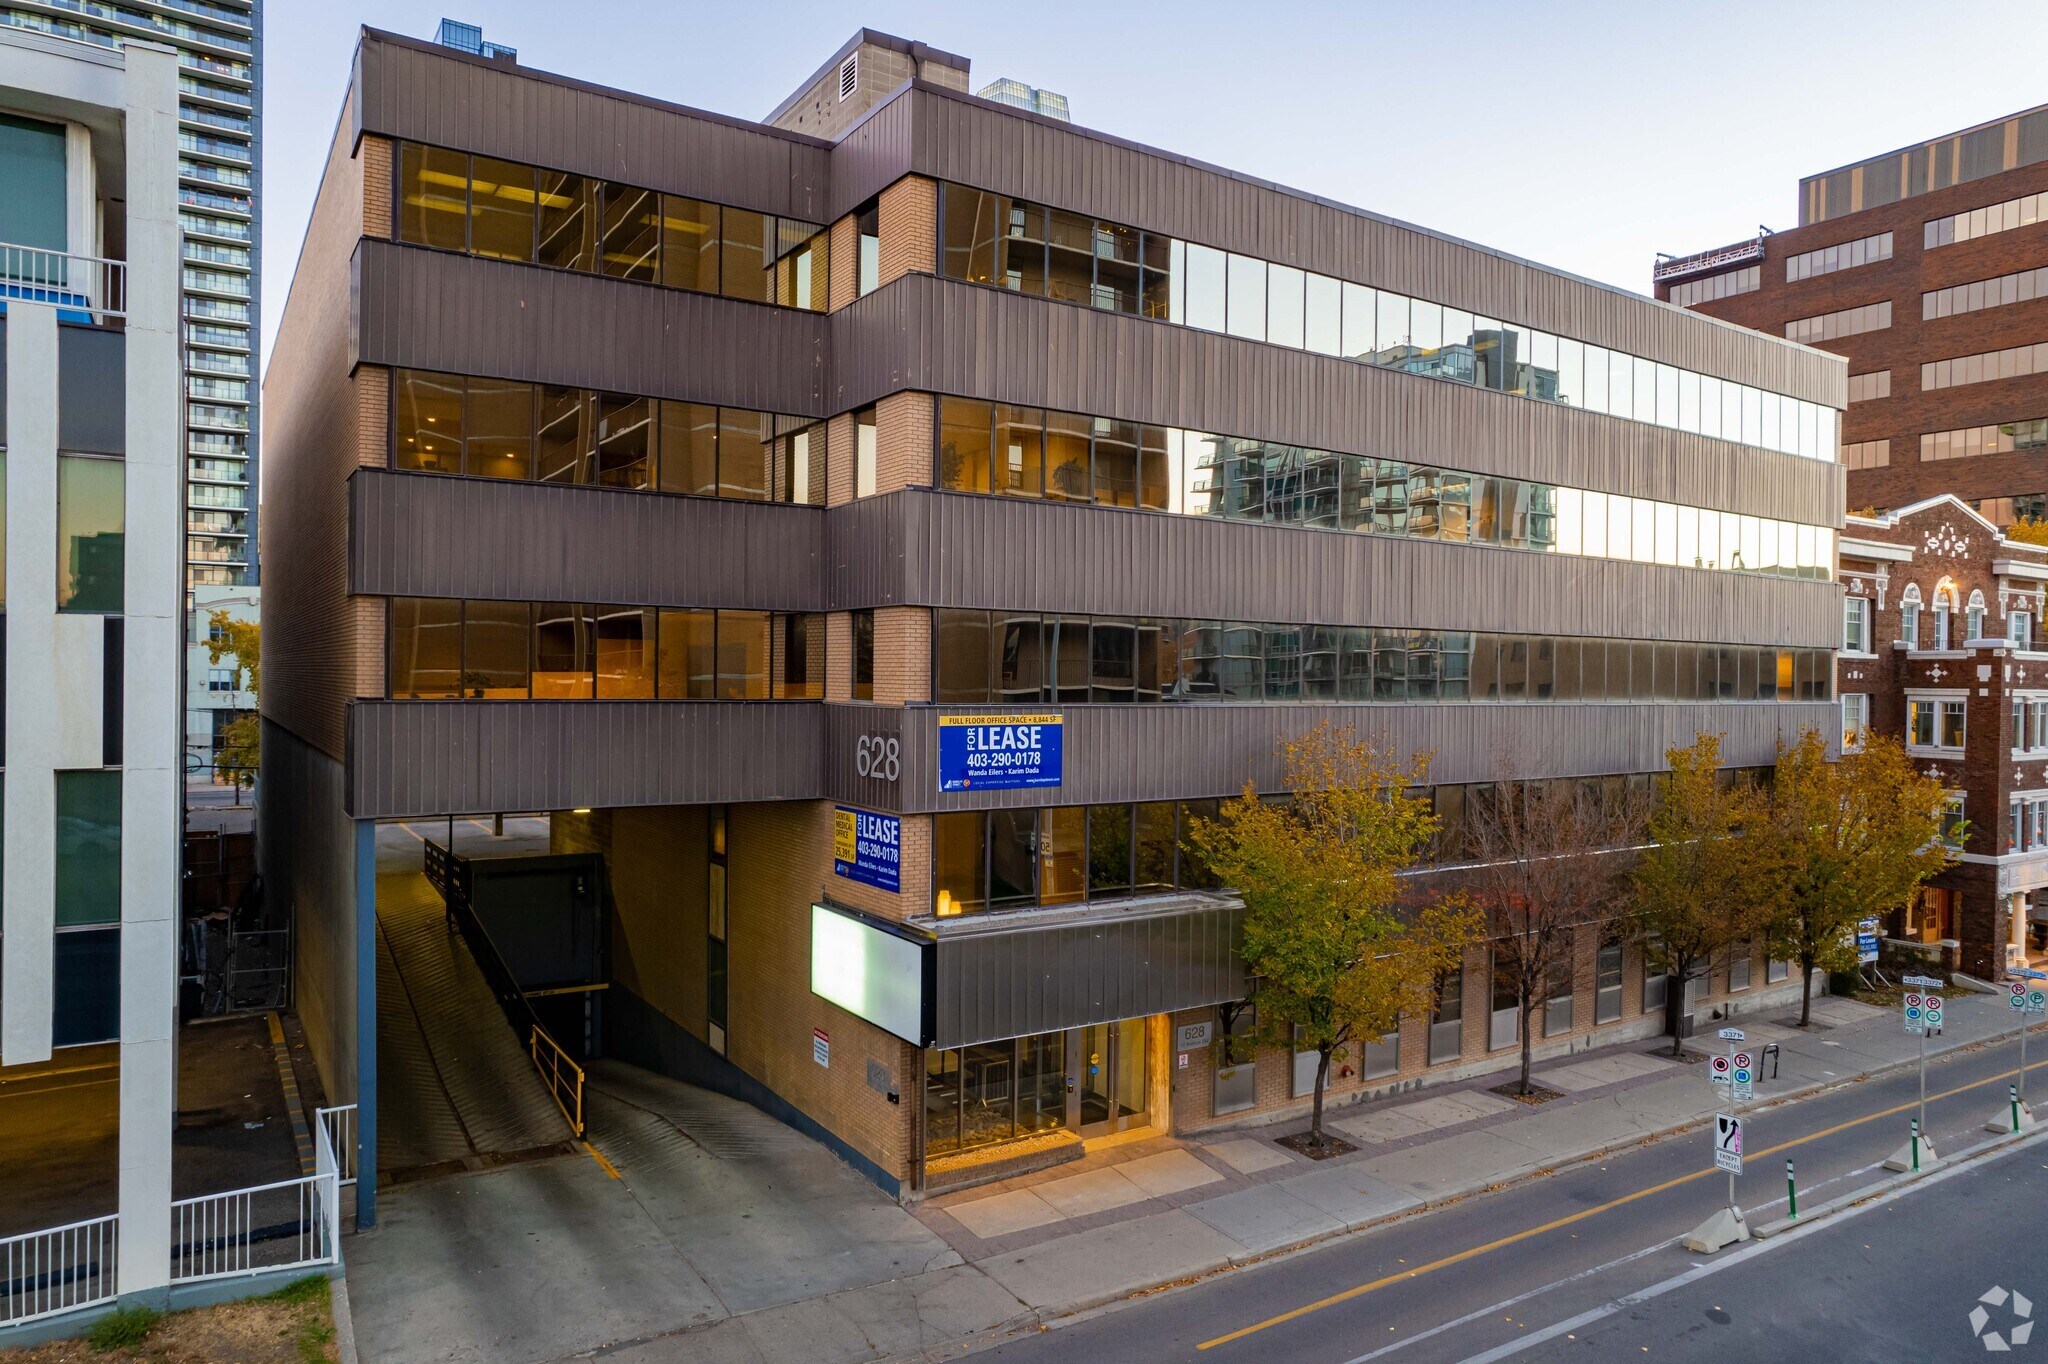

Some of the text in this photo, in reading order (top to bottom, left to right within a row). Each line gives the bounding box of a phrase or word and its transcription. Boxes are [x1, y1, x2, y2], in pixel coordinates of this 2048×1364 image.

[967, 728, 975, 750] FOR
[978, 726, 1042, 750] LEASE
[857, 735, 899, 781] 628
[967, 752, 1041, 767] 403-290-0178
[988, 768, 1003, 776] Eilers
[836, 829, 848, 839] OFFICE
[863, 815, 898, 845] LEASE
[858, 840, 898, 863] 403-290-0178
[1185, 1026, 1204, 1039] 628
[1718, 1159, 1740, 1171] BICYCLES
[1720, 1153, 1737, 1162] EXCEPT
